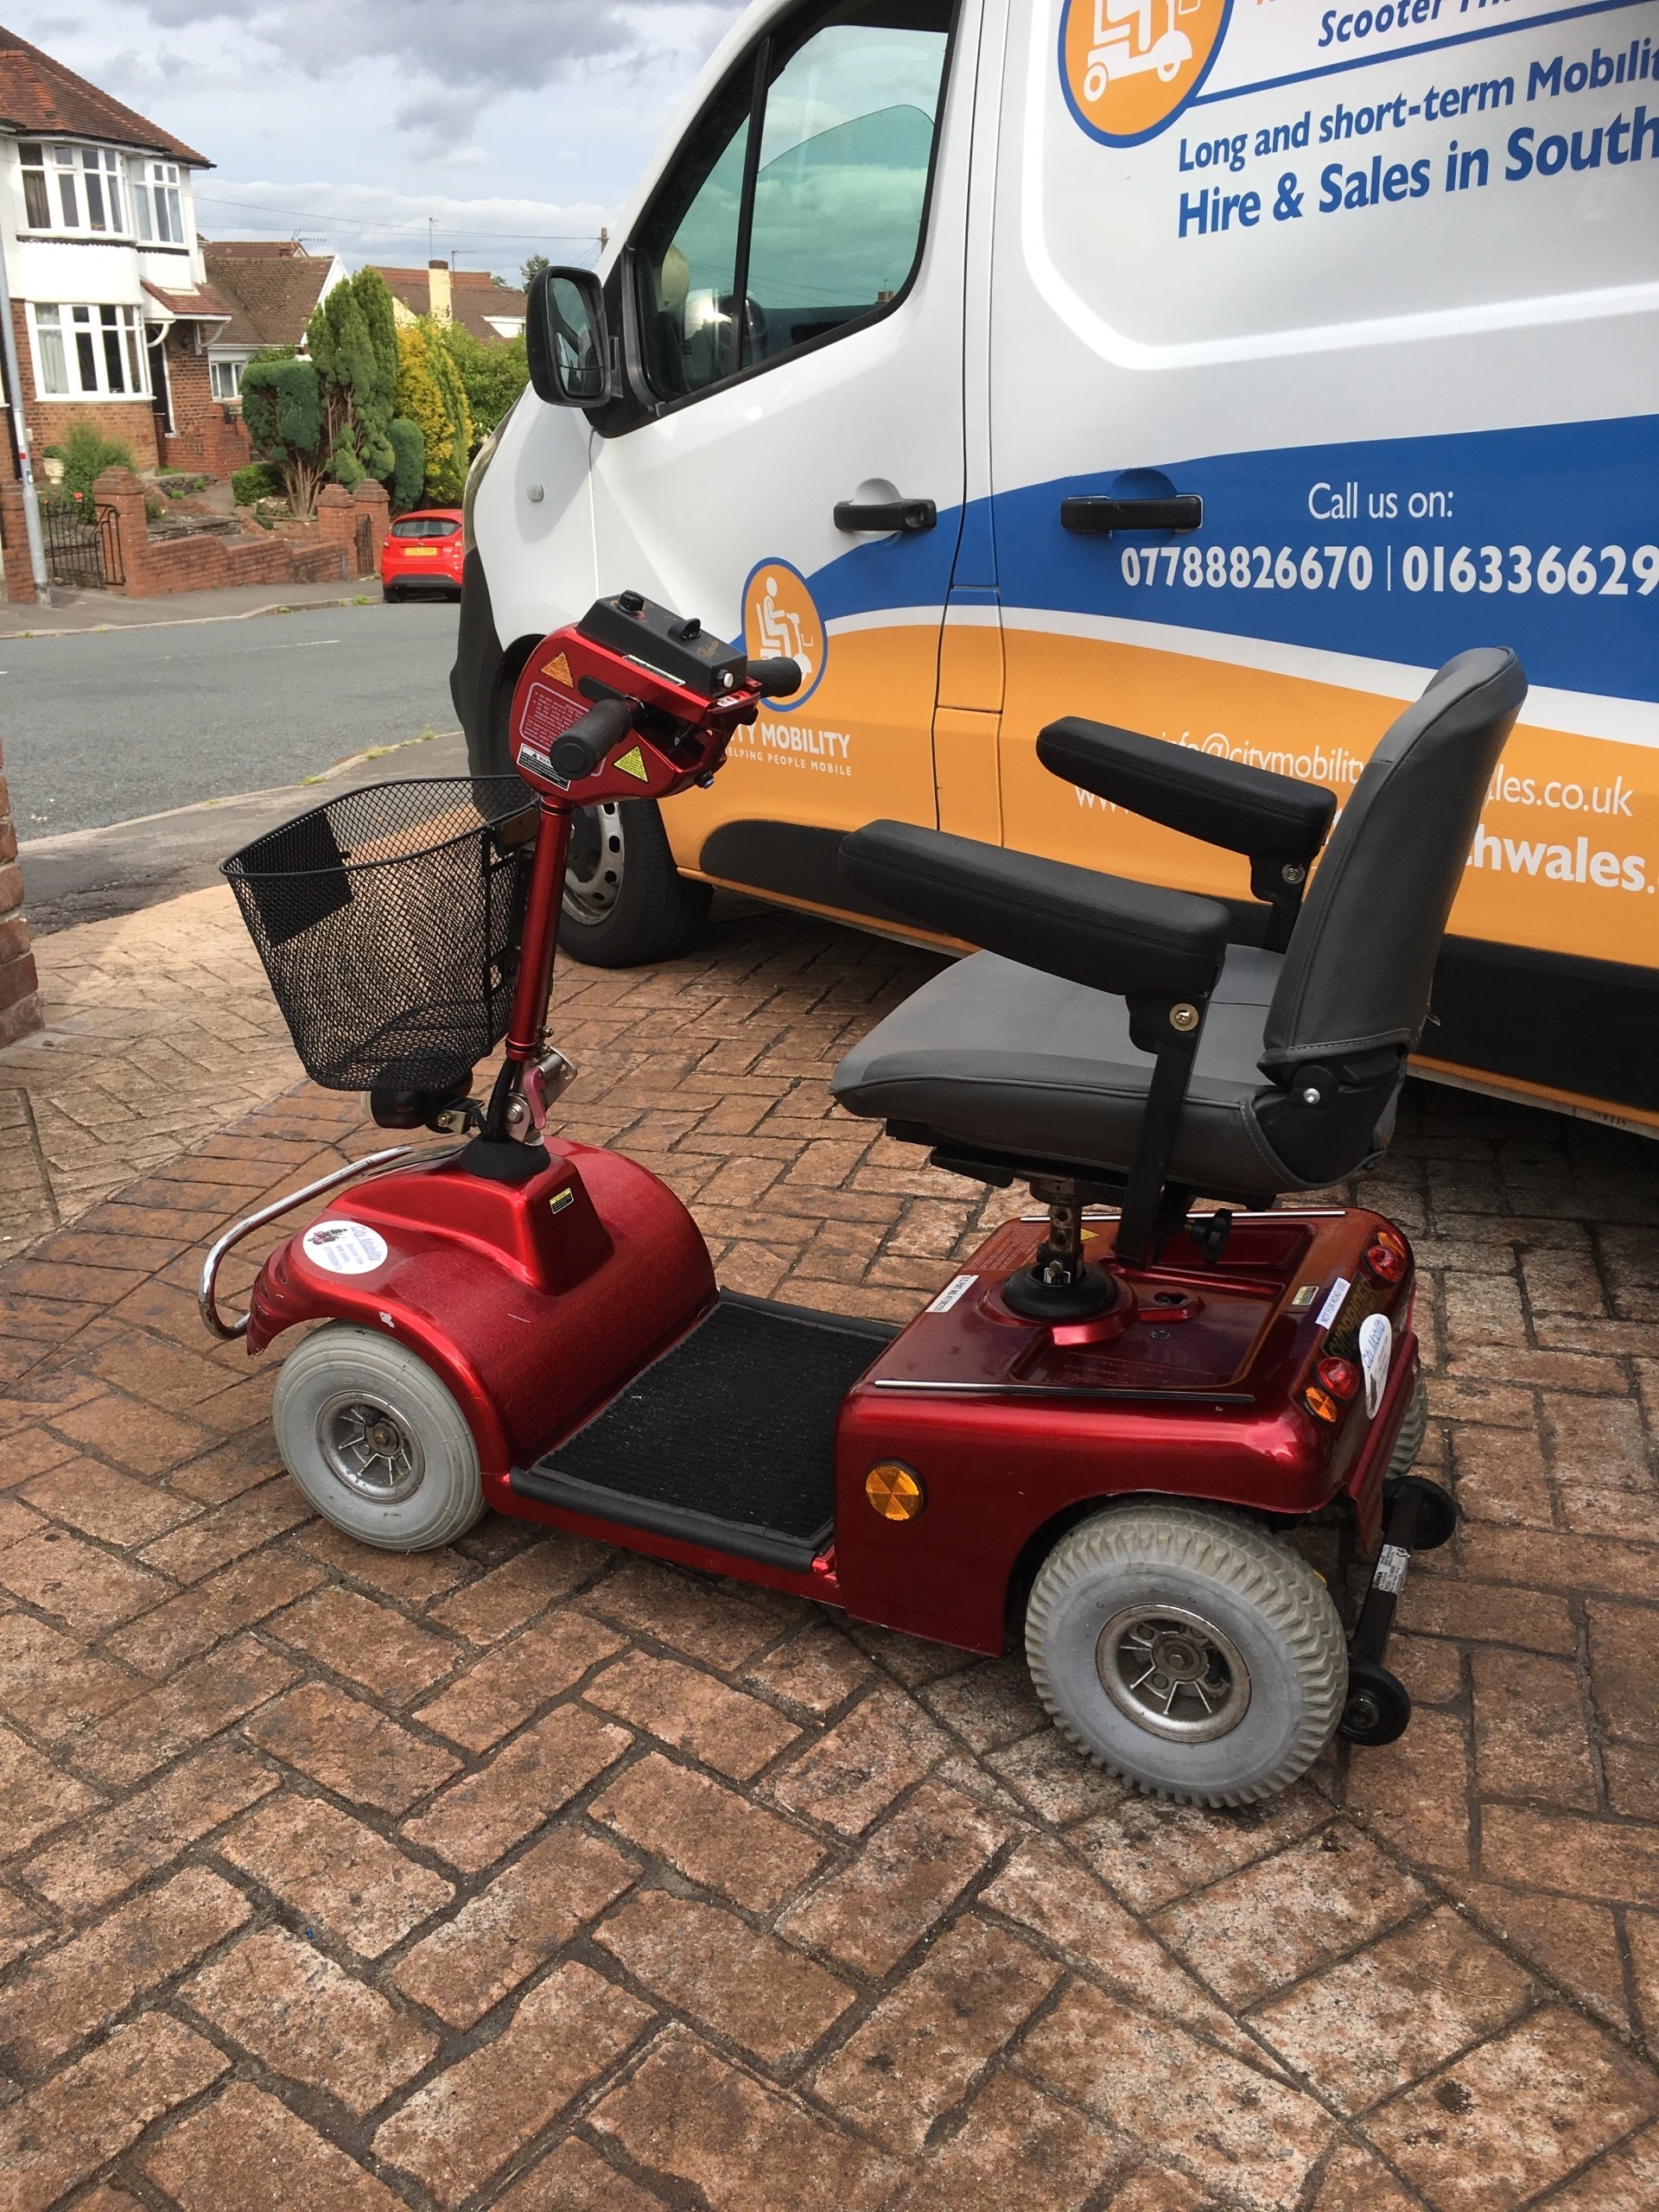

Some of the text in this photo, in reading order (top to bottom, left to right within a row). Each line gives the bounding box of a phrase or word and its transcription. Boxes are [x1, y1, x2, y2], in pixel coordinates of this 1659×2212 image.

[1318, 0, 1440, 47] Scooter
[1179, 136, 1248, 173] Long
[1255, 111, 1312, 156] and
[1319, 79, 1514, 144] short-term
[1178, 105, 1659, 238] Hire & Sales in South
[1308, 481, 1454, 520] Call us on:
[1121, 544, 1659, 595] 07788826670 016336629
[730, 722, 850, 759] TY MOBILITY
[767, 753, 806, 769] PEOPLE
[810, 760, 852, 777] MOBILE
[1466, 823, 1656, 894] hwales.
